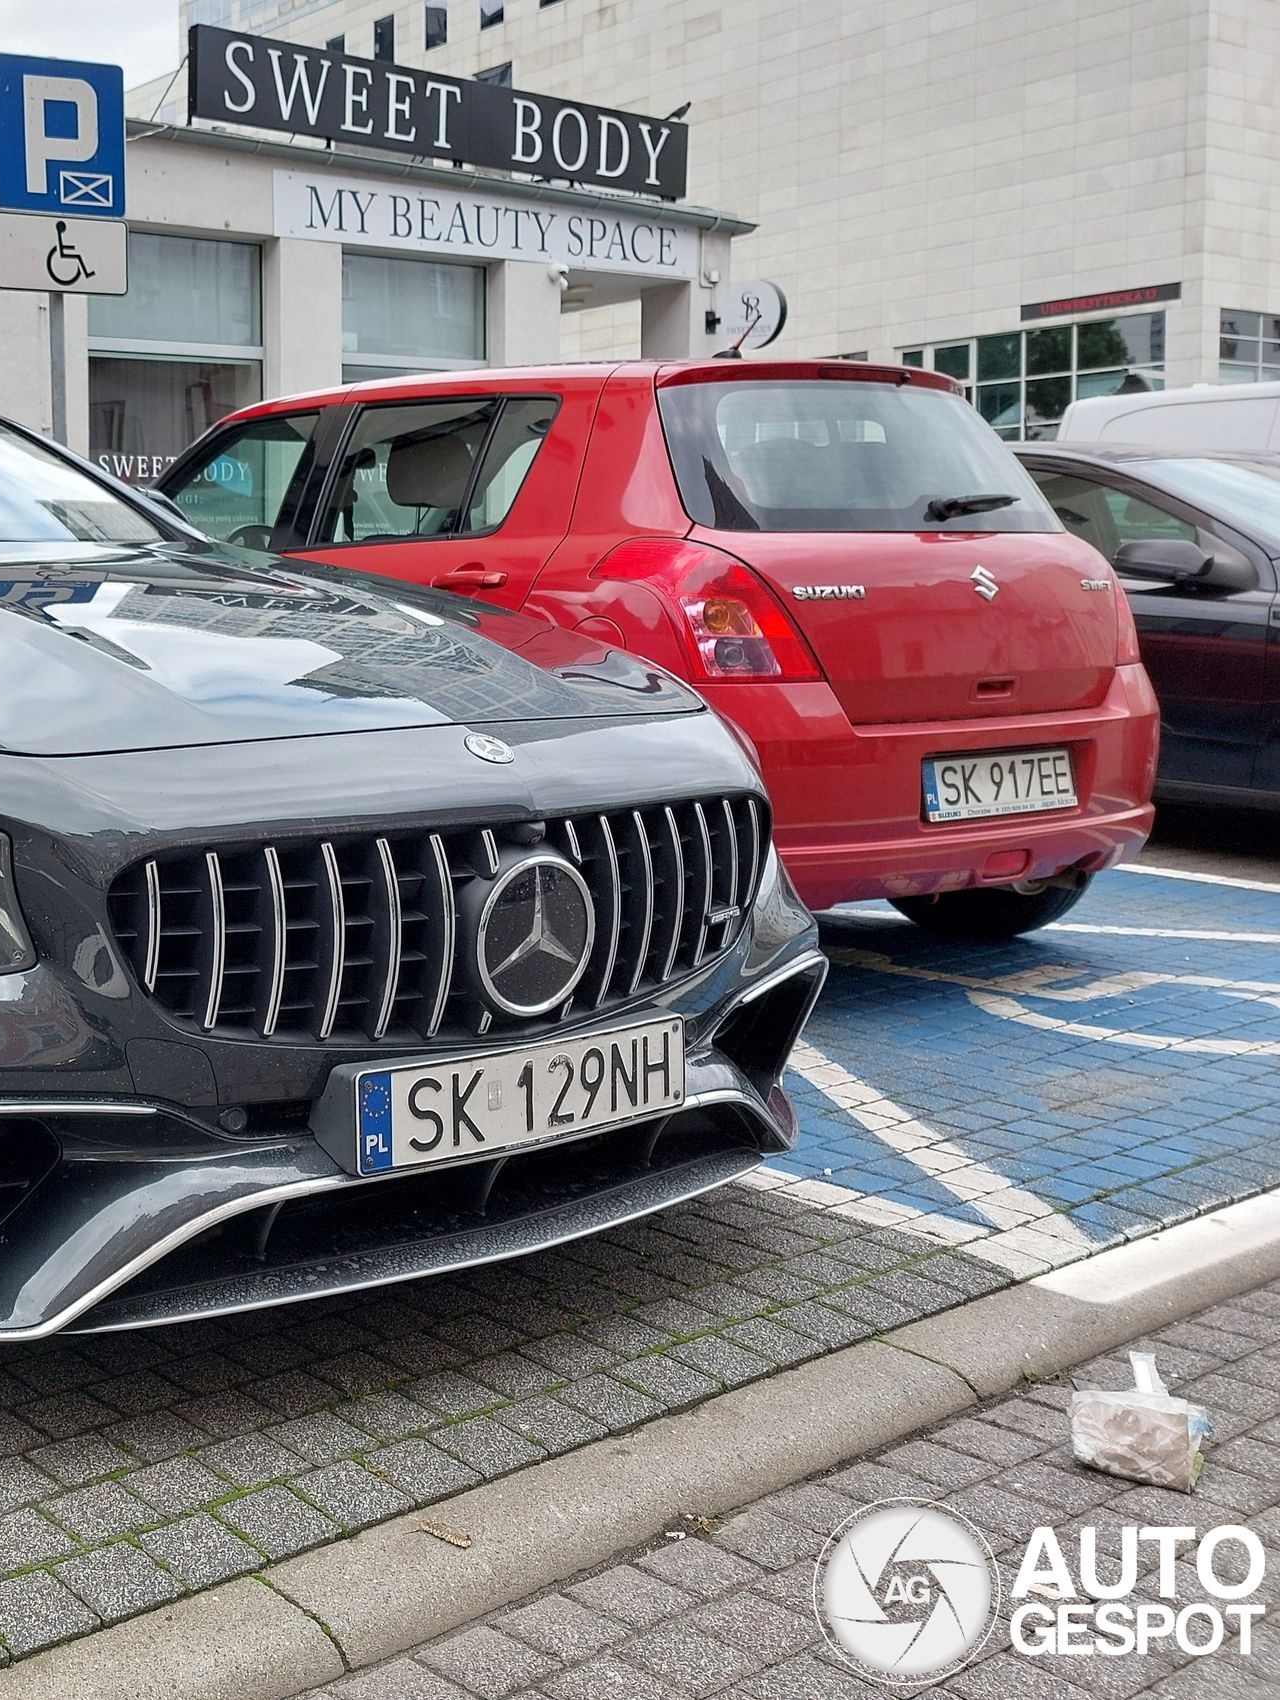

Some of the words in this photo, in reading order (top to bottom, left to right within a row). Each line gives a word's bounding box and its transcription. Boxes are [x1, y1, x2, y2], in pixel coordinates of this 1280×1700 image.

[23, 74, 99, 194] P
[223, 40, 462, 149] SWEET
[511, 97, 672, 187] BODY
[305, 185, 379, 235] MY
[389, 195, 558, 253] BEAUTY
[567, 216, 678, 267] SPACE
[792, 585, 866, 600] SUZUKI
[927, 793, 938, 805] PL
[941, 764, 982, 806] SK
[990, 755, 1070, 801] 917EE
[408, 1069, 486, 1152] SK
[517, 1031, 670, 1131] 129NH
[365, 1134, 388, 1156] PL
